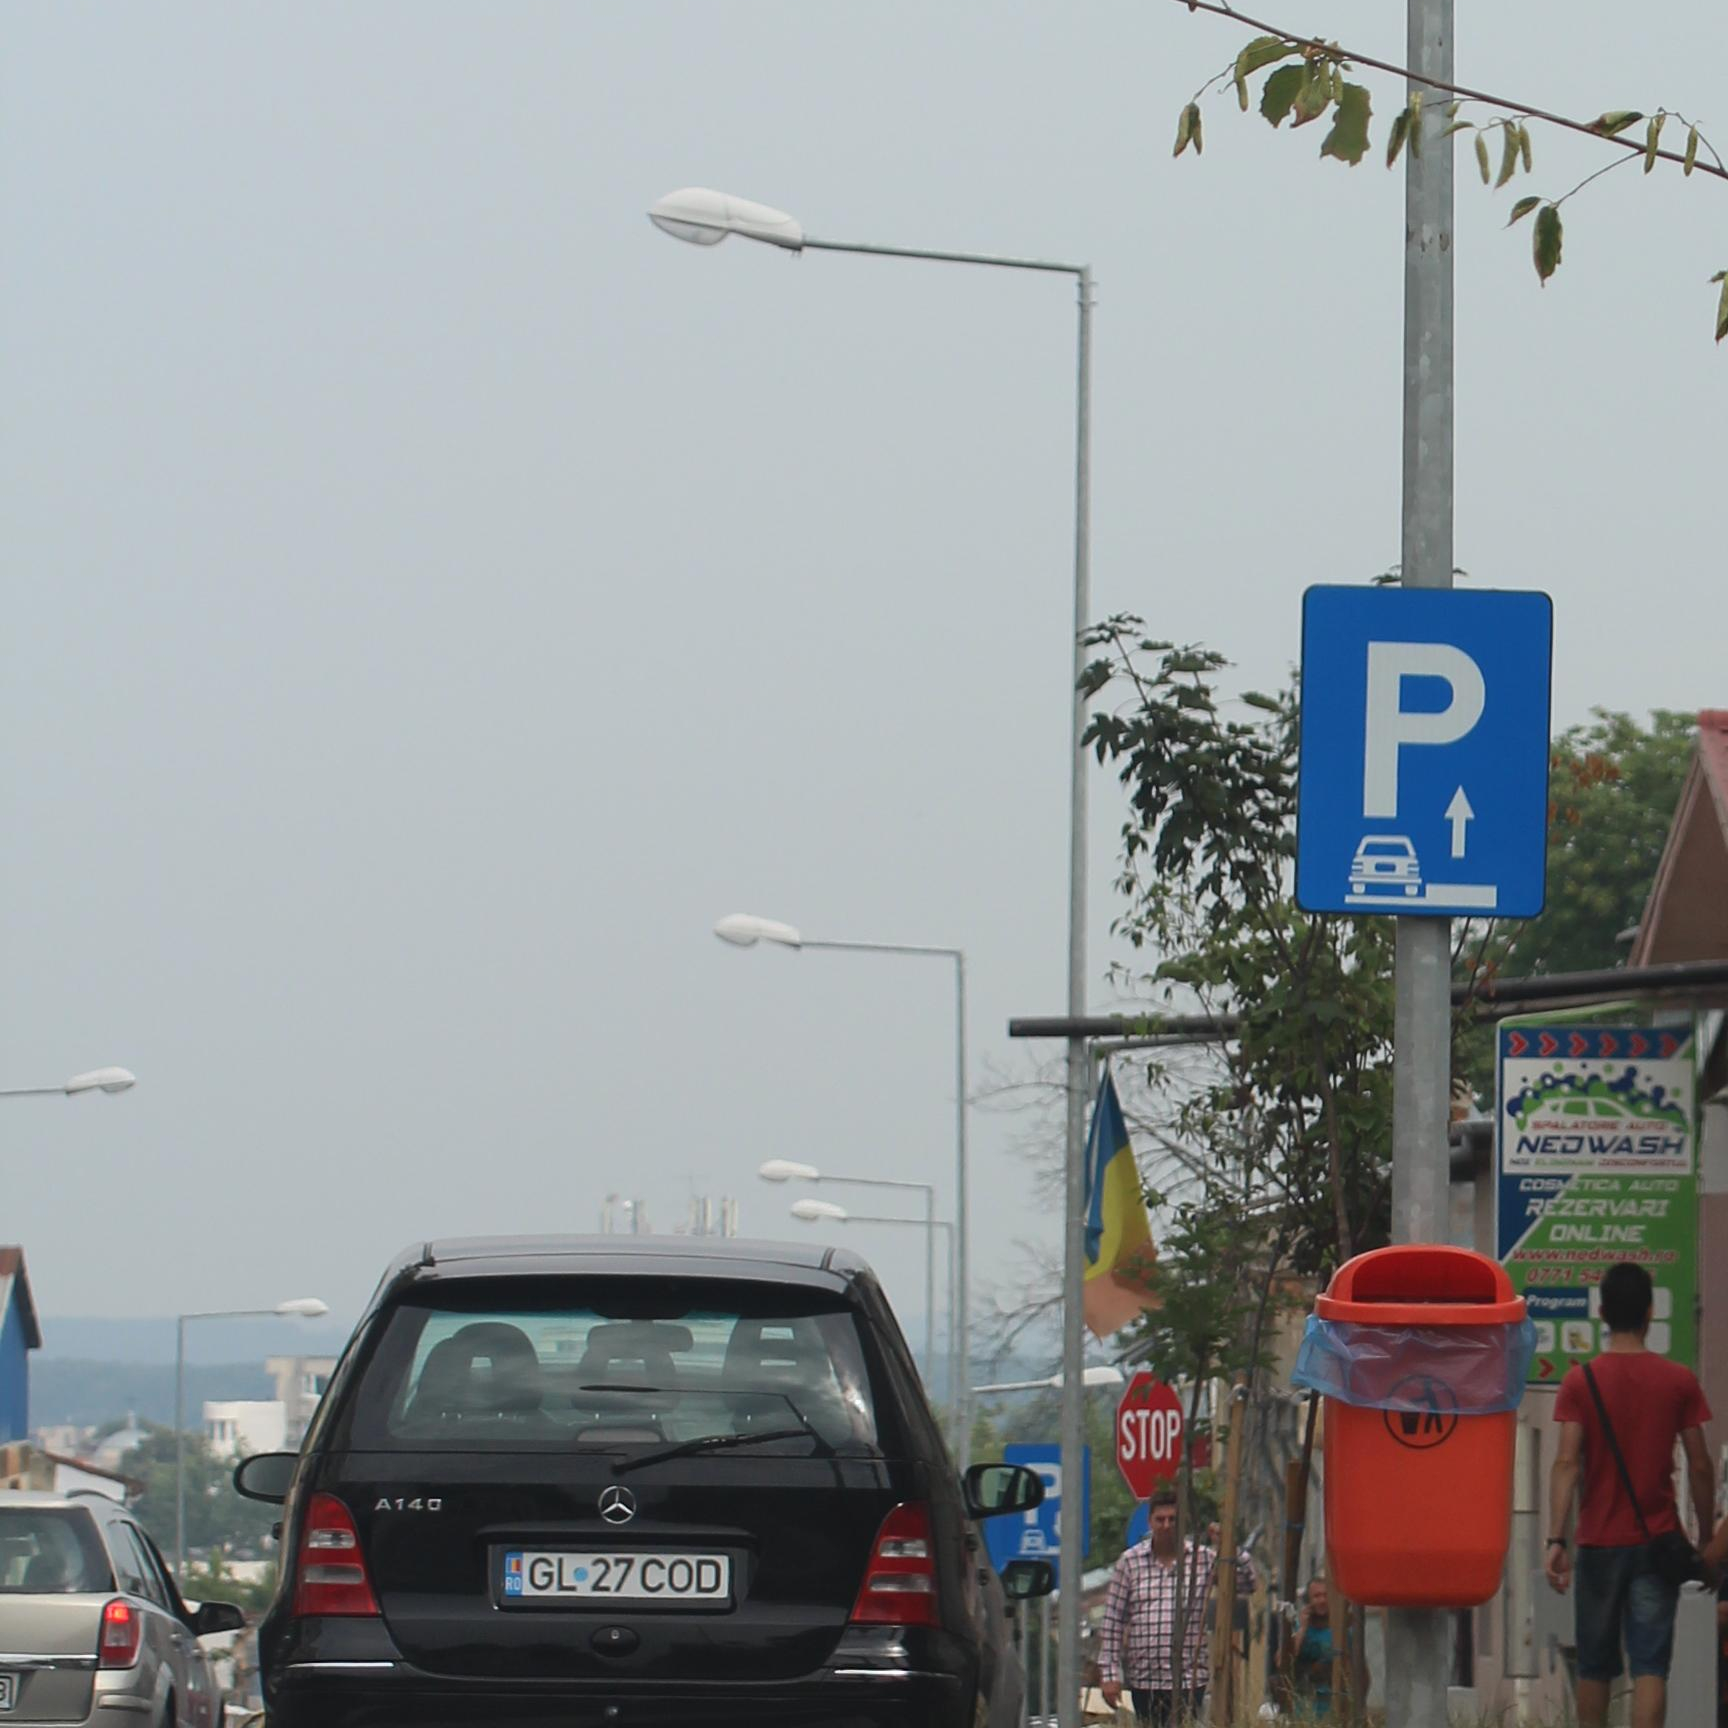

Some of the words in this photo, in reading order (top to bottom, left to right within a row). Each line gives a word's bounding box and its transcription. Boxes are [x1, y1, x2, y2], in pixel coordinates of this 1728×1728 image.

[1363, 641, 1486, 819] P
[1516, 1135, 1686, 1154] NEDWASH
[1519, 1178, 1620, 1191] COSMETICA
[1628, 1179, 1678, 1191] AUTO
[1525, 1198, 1670, 1217] REZERVARI
[1549, 1224, 1645, 1242] ONLINE
[1512, 1248, 1678, 1262] www.nedwash.ro
[1526, 1267, 1572, 1284] 0771
[1526, 1293, 1587, 1310] Program
[1121, 1409, 1181, 1461] STOP
[375, 1498, 442, 1512] A140
[505, 1576, 521, 1591] RO
[529, 1557, 577, 1592] GL
[590, 1557, 635, 1593] 27
[640, 1558, 722, 1594] COD
